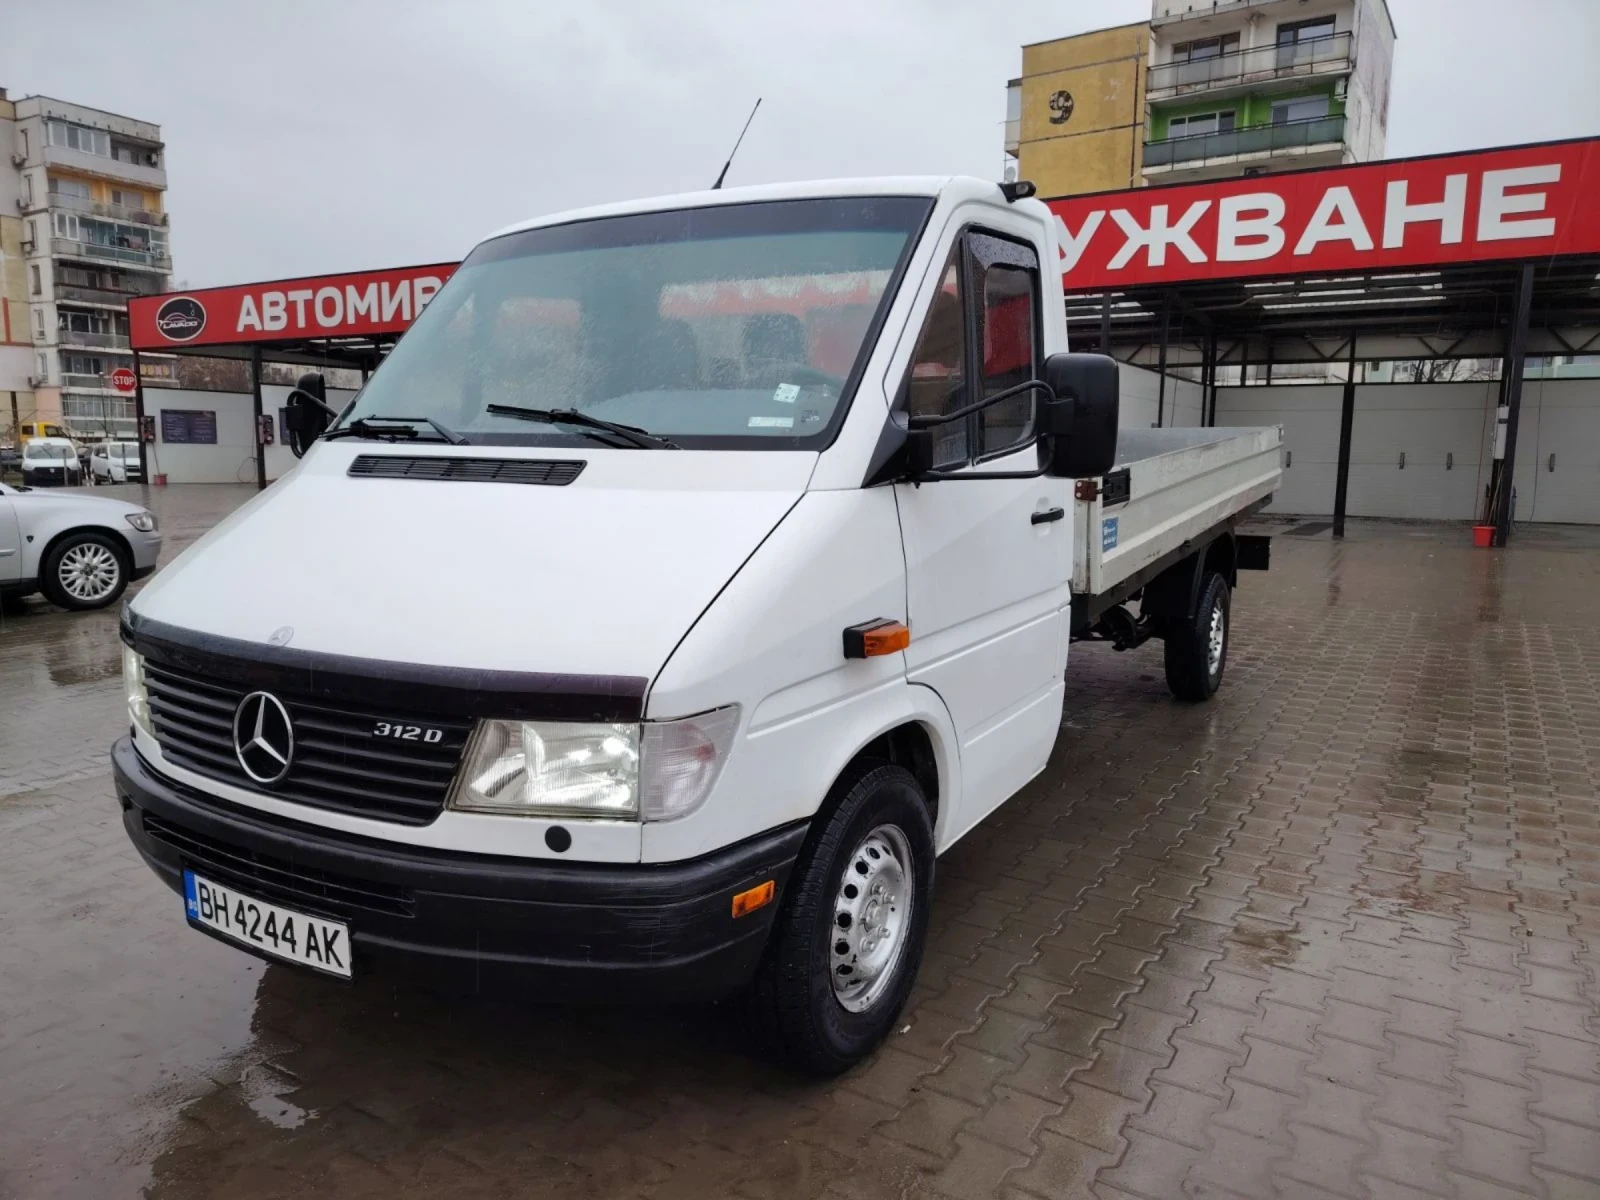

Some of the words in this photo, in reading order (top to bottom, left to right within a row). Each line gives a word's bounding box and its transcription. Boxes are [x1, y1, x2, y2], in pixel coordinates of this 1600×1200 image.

[1049, 90, 1074, 125] 9
[236, 275, 450, 332] АВТОМИВ
[113, 375, 135, 386] STOP
[234, 899, 297, 954] 4244
